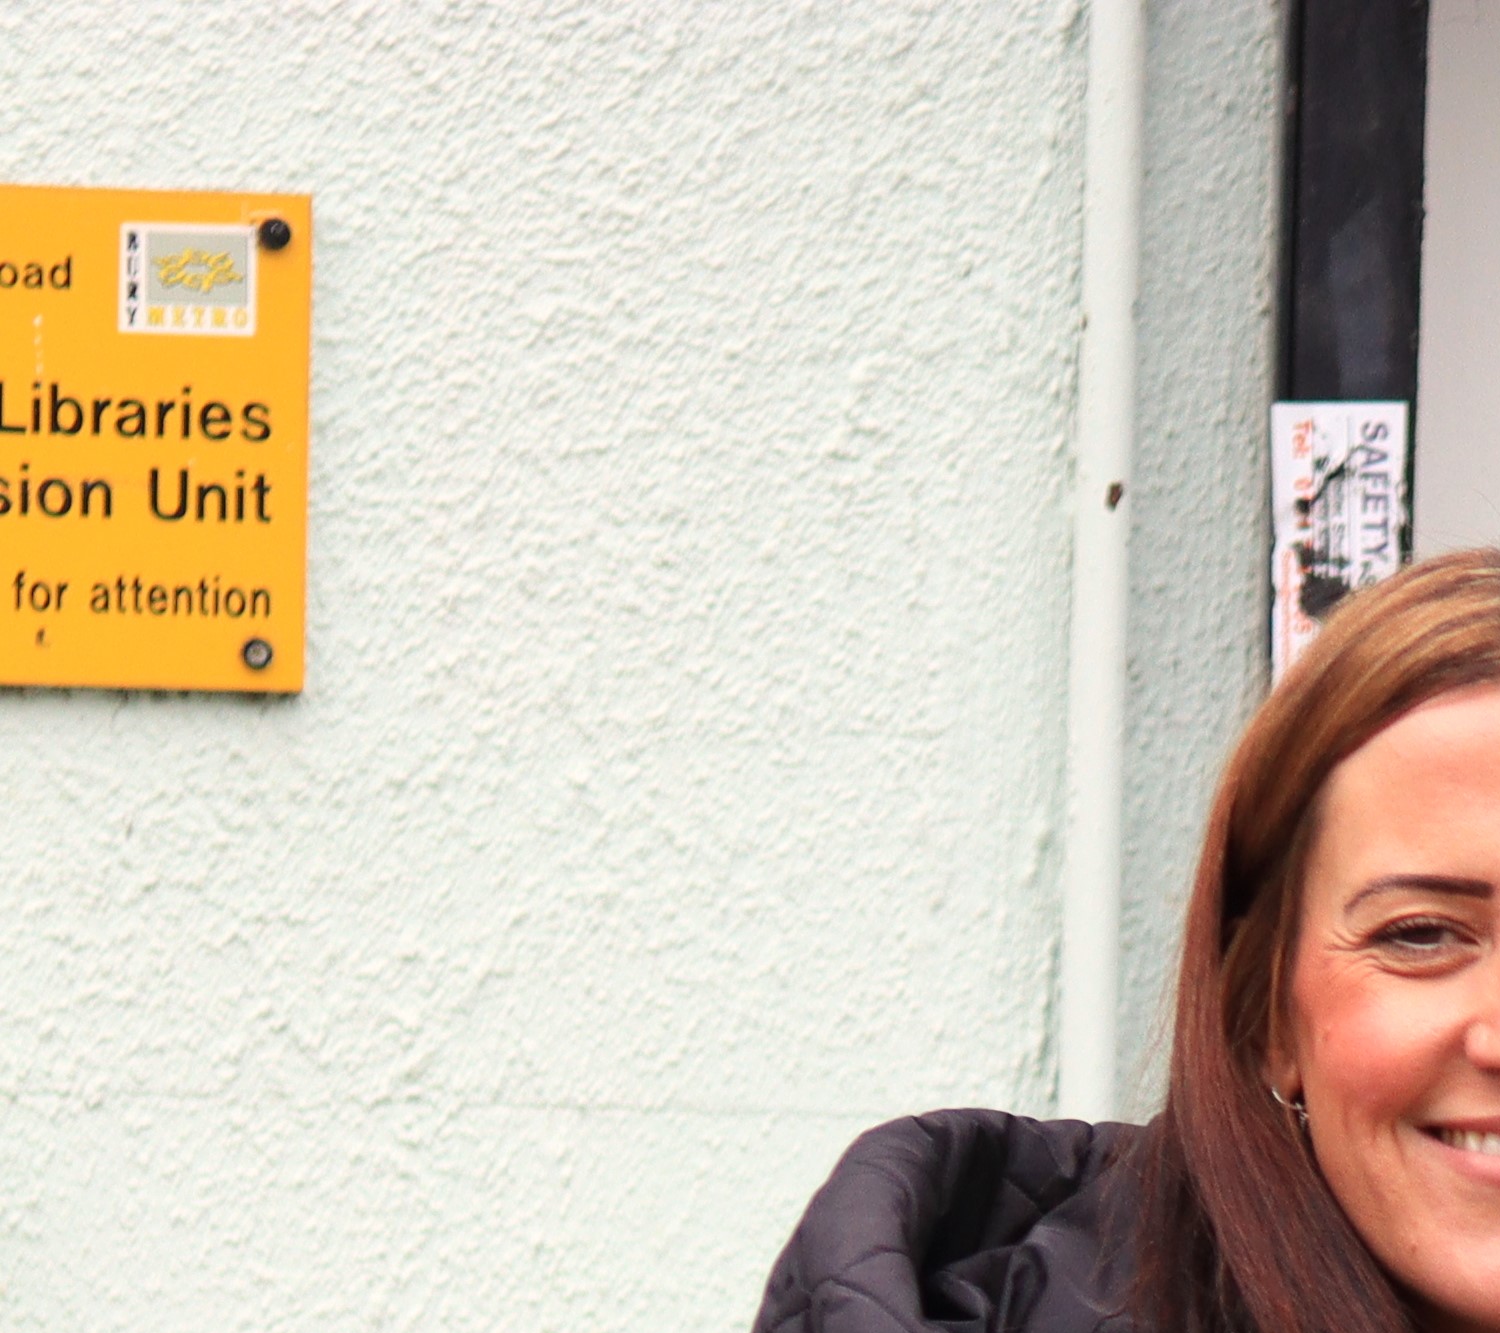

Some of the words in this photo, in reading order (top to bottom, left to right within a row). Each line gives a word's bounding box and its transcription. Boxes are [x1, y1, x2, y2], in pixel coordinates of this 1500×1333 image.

[0, 381, 272, 442] Libraries
[148, 466, 272, 524] Unit
[1359, 420, 1390, 564] SAFETY
[13, 570, 68, 613] for
[89, 574, 272, 619] attention
